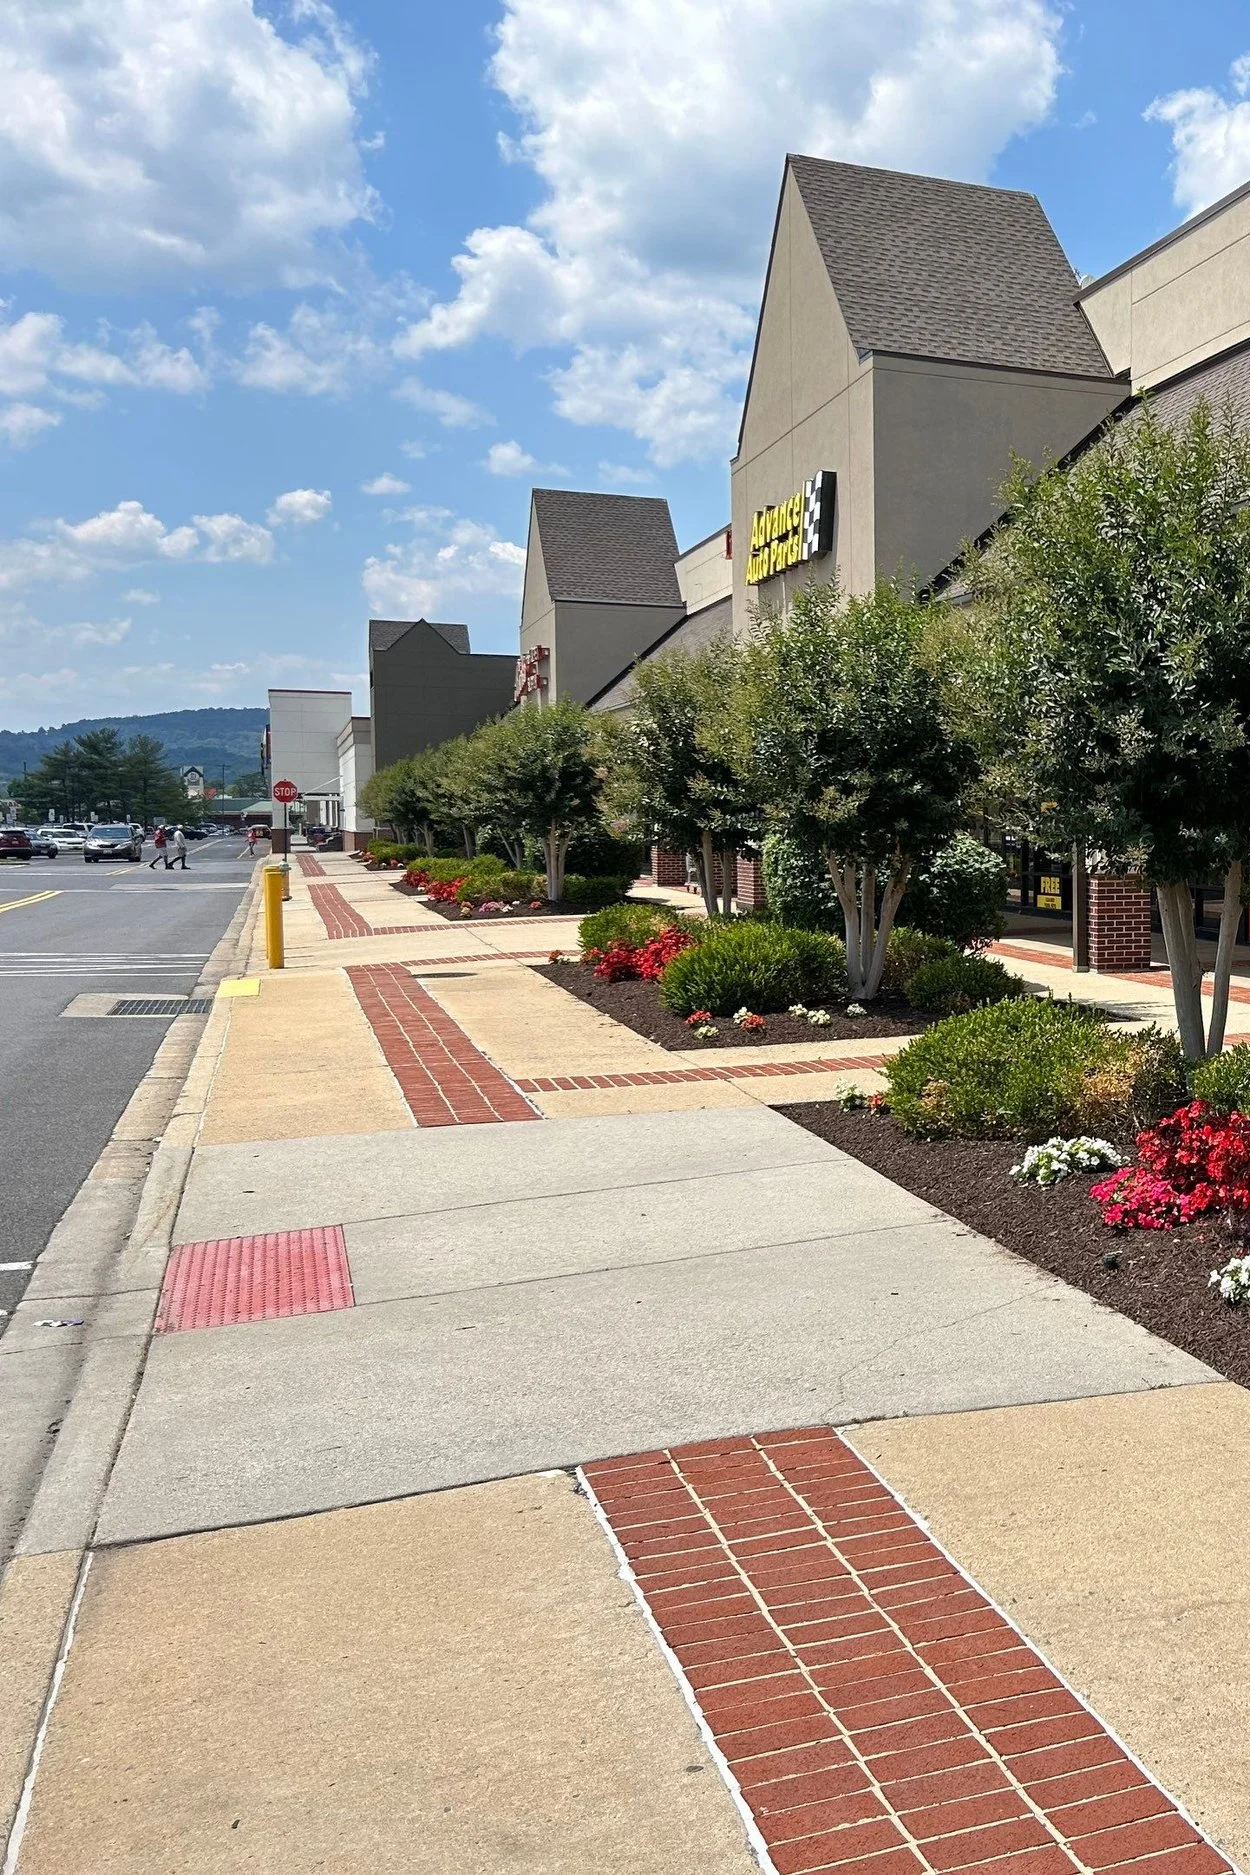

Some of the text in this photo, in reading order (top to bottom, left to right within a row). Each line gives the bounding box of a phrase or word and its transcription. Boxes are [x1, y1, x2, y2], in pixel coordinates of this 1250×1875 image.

[750, 493, 800, 551] Advance
[745, 531, 799, 585] Auto Parts
[274, 787, 297, 797] STOP
[1040, 876, 1060, 894] FREE
